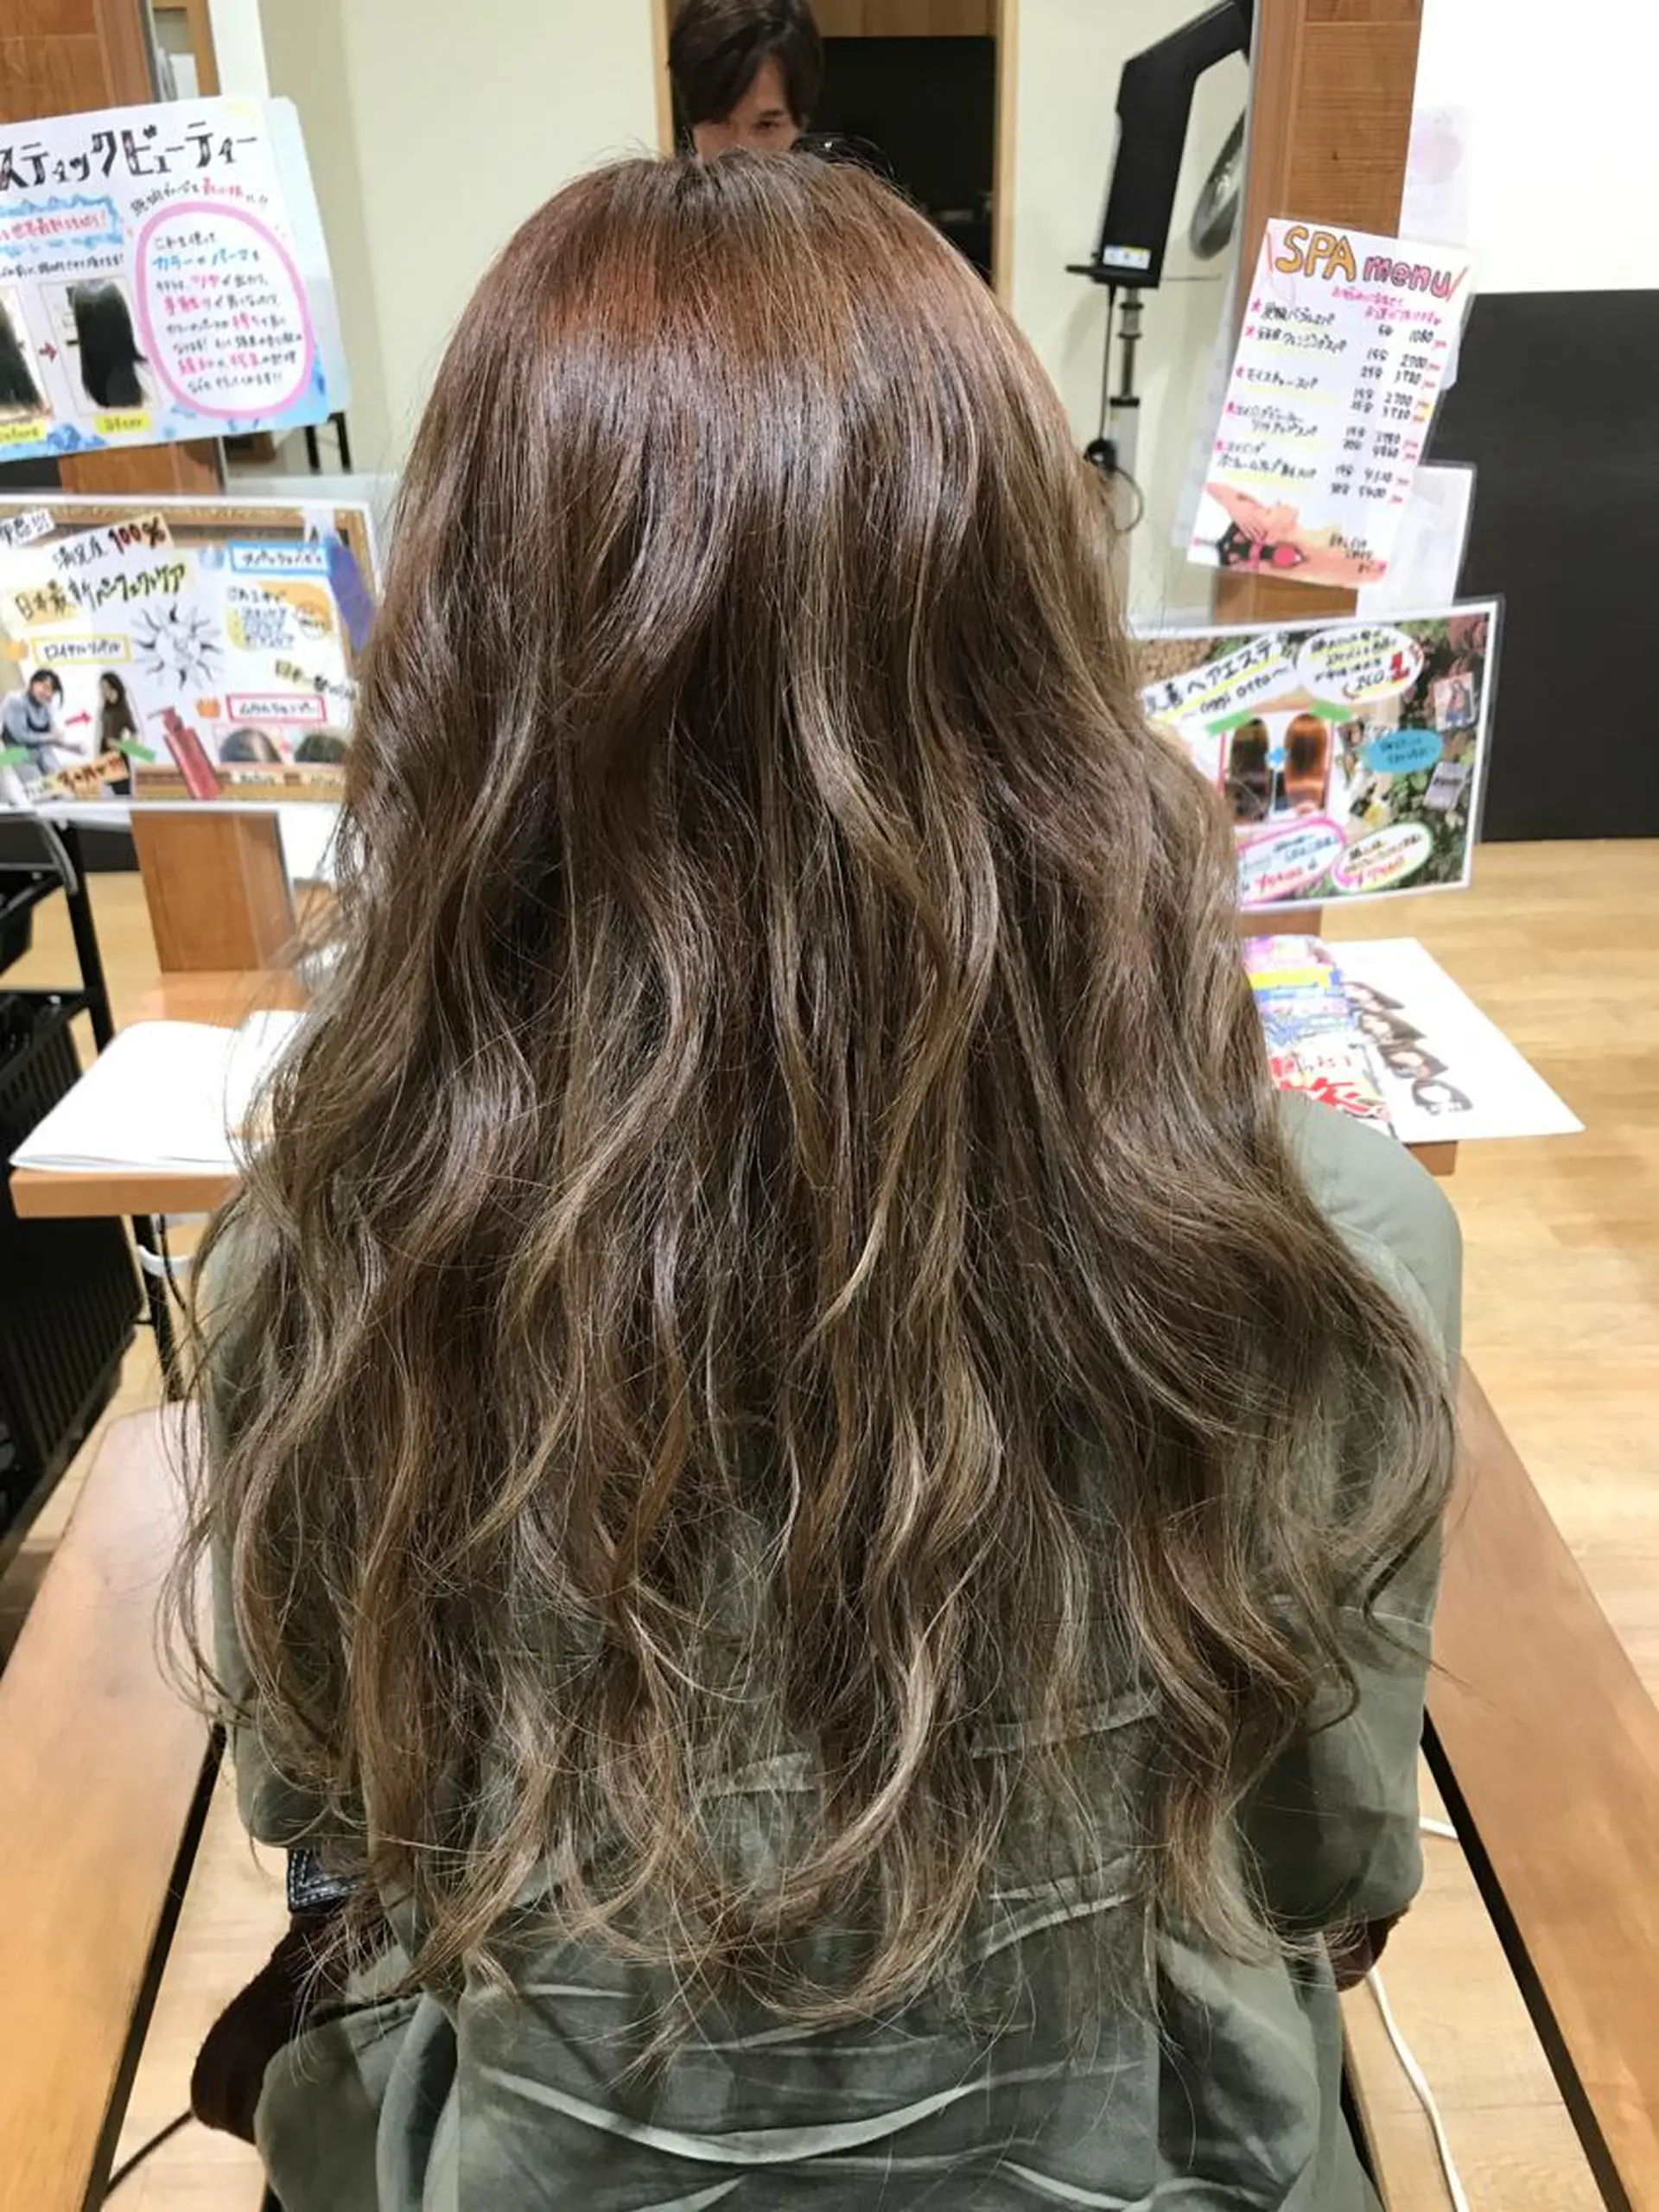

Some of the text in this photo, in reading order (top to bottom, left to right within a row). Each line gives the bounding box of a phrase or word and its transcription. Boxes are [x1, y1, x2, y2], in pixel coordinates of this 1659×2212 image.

[1274, 226, 1454, 299] SPA menu
[107, 516, 167, 556] 100%
